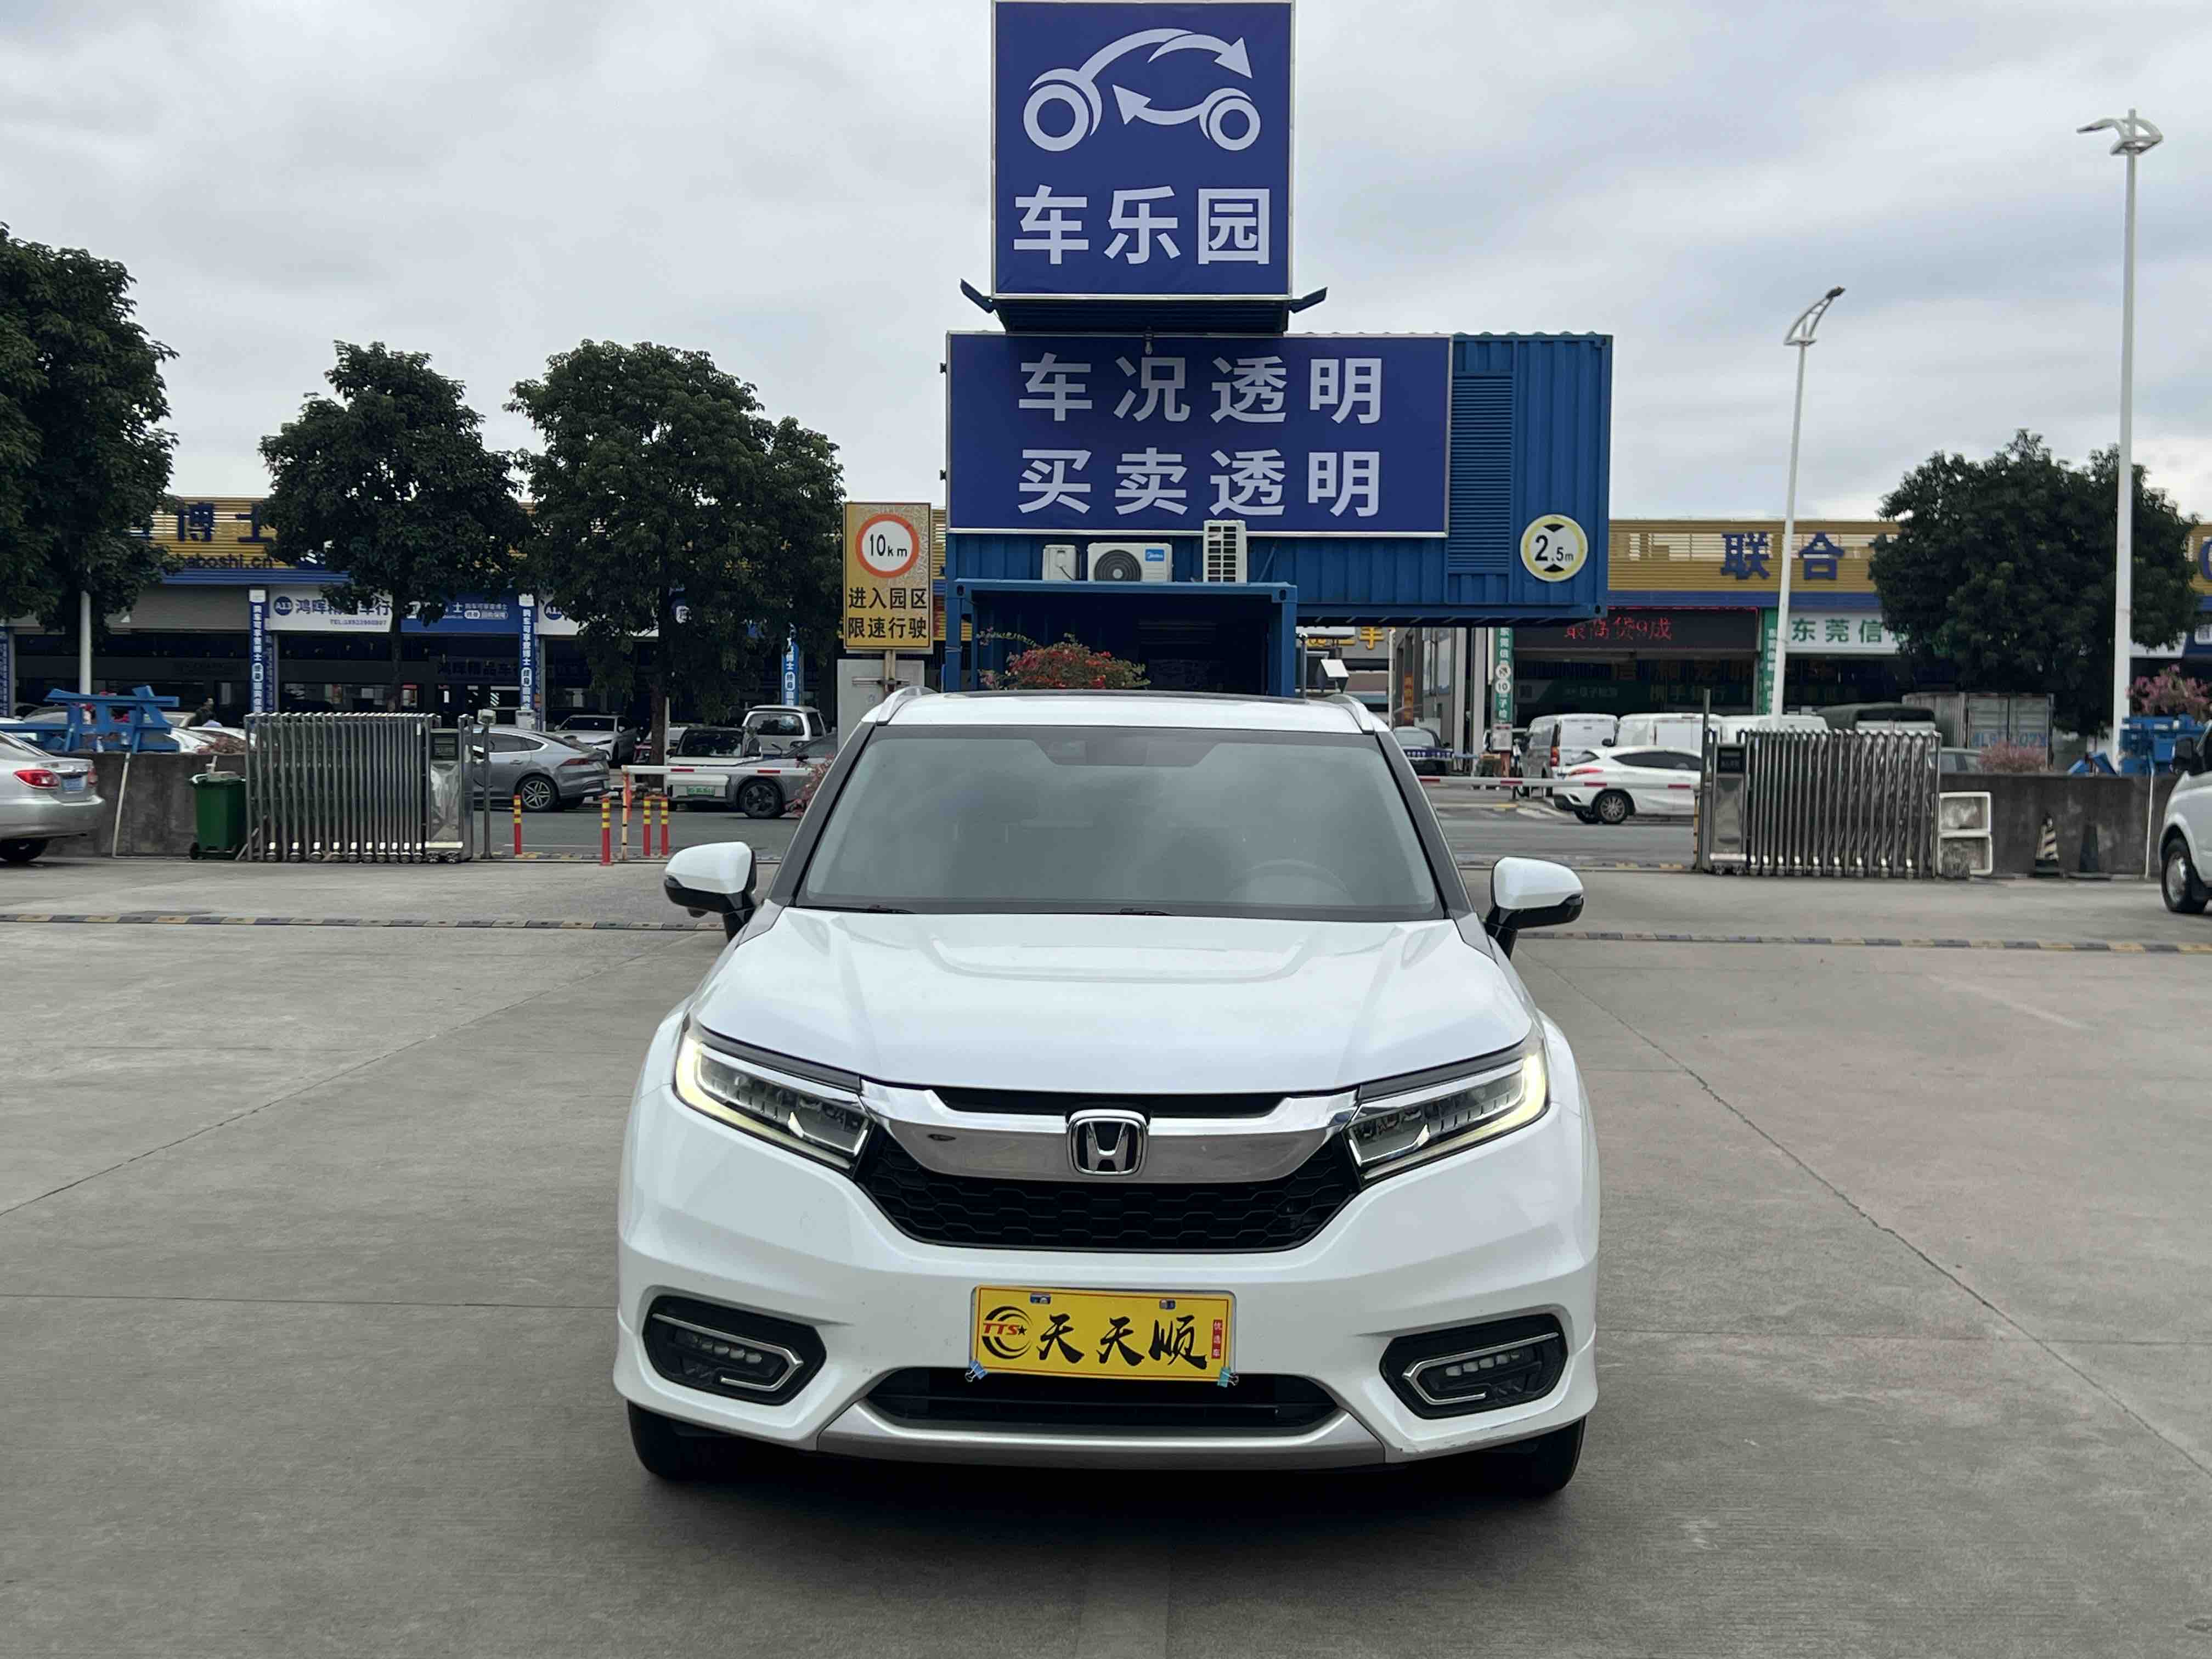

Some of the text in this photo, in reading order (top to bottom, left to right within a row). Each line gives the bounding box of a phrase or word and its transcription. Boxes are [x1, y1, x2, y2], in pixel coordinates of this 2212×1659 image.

[1013, 184, 1270, 264] 车乐园
[1018, 353, 1383, 424] 车况透明
[1018, 447, 1381, 517] 买卖透明
[132, 501, 274, 543] 博士
[1720, 531, 1844, 580] 联合
[848, 587, 928, 610] 进入园区
[848, 617, 928, 639] 限速行驶
[1792, 618, 1898, 644] 东莞信
[983, 1322, 1019, 1335] TTS
[1037, 1313, 1207, 1370] 天天顺
